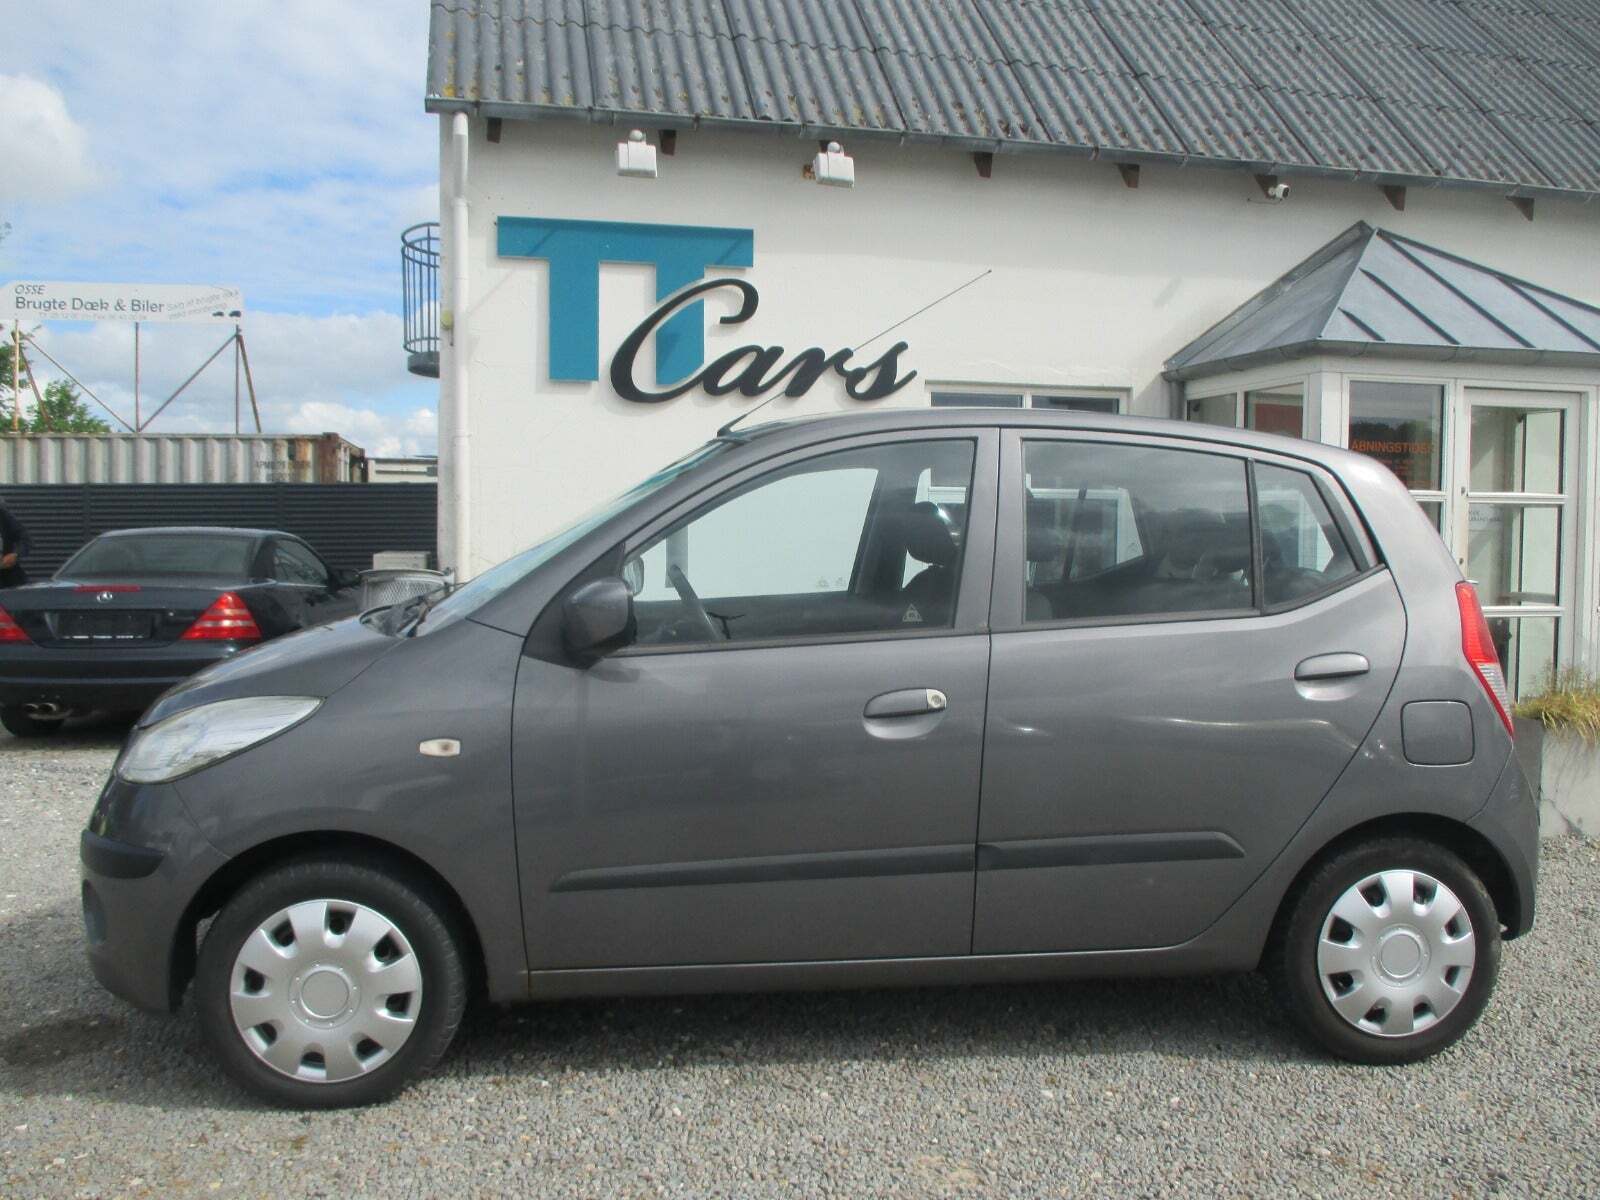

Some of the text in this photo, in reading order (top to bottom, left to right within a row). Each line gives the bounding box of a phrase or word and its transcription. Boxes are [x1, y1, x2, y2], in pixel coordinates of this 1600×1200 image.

[14, 284, 47, 295] OSSE
[15, 296, 67, 312] Brugte
[114, 298, 127, 311] &
[131, 298, 165, 313] Biler
[497, 216, 754, 386] TT
[610, 278, 917, 403] Cars
